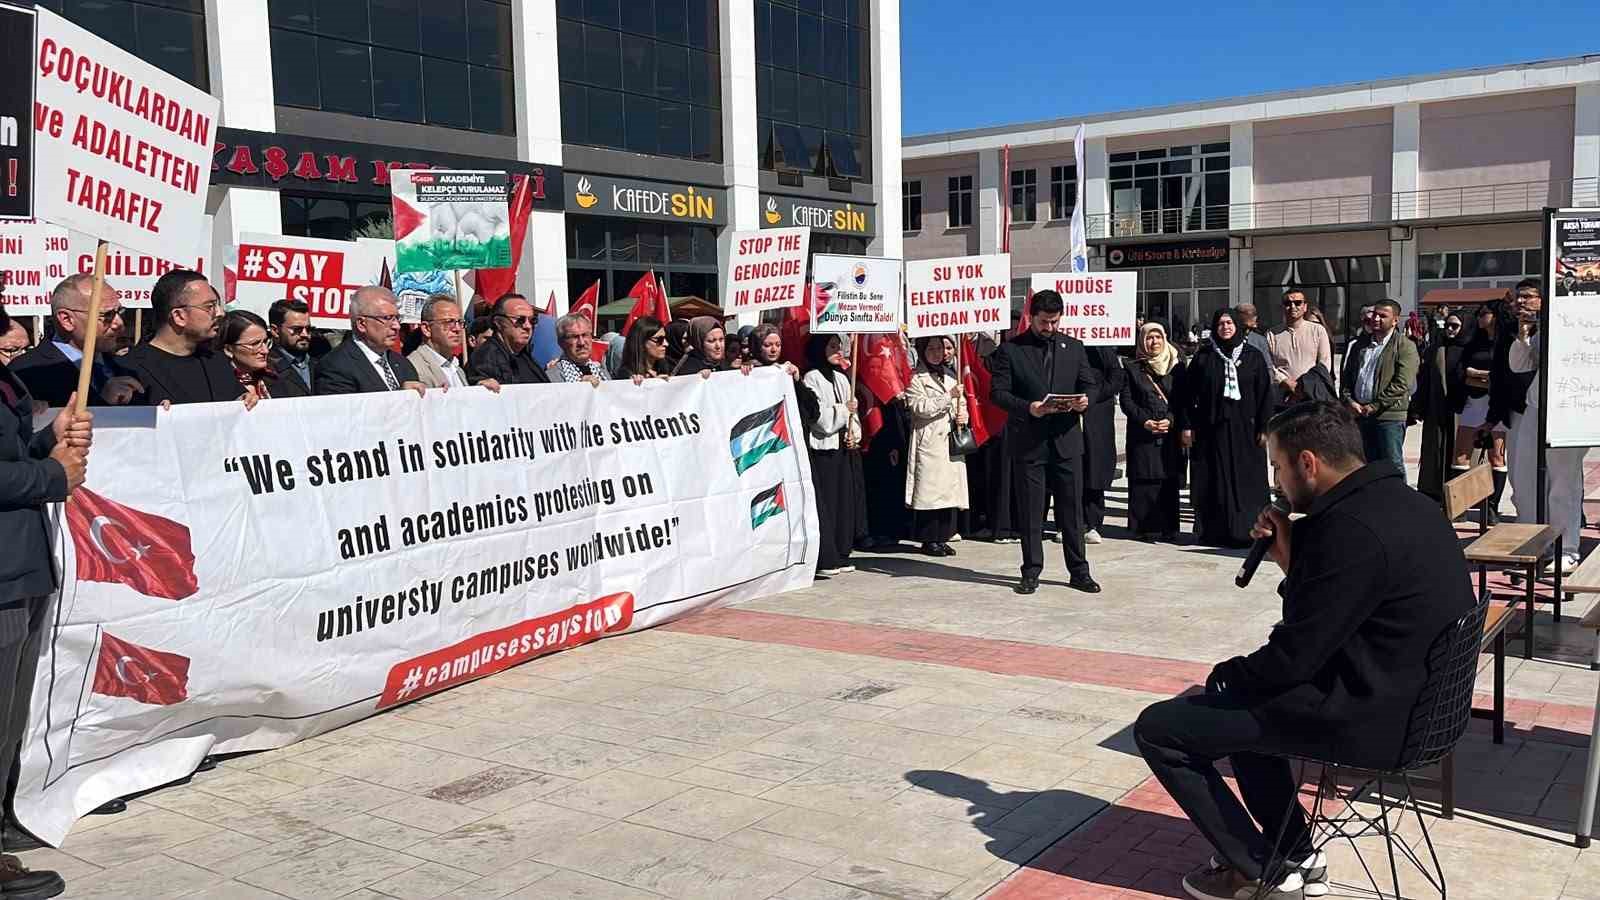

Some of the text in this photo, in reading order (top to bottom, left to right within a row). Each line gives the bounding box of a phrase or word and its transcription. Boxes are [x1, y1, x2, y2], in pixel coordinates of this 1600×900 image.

[39, 38, 210, 146] ÇOÇUKLARDAN
[35, 102, 200, 195] ve ADALETTEN
[440, 173, 485, 183] AKADEMİYE
[67, 168, 163, 233] TARAFIZ
[421, 185, 505, 195] KELEPÇE VURULAMAZ
[739, 235, 801, 256] STOP THE
[243, 248, 329, 282] #SAY
[735, 257, 801, 282] GENOCİDE
[934, 264, 983, 282] SU YOK
[735, 284, 795, 306] IN GAZZE
[837, 291, 883, 300] Filistin Bu Sene
[911, 285, 1006, 306] ELEKTRİK YOK
[1056, 277, 1113, 293] KUDÜSE
[825, 311, 893, 324] Dünya Sınıfta Kaldı!
[839, 303, 883, 311] Mezun Vermedi!
[1063, 302, 1078, 317] İN
[917, 310, 1000, 328] VİCDAN YOK
[1091, 326, 1131, 339] SELAM
[306, 441, 391, 487] stand
[398, 438, 425, 473] in
[433, 426, 535, 469] solidarity
[540, 421, 577, 454] with
[580, 419, 604, 448] the
[611, 411, 700, 445] students
[338, 471, 653, 560] and academics protesting on
[316, 579, 443, 642] universty
[451, 550, 559, 603] campuses
